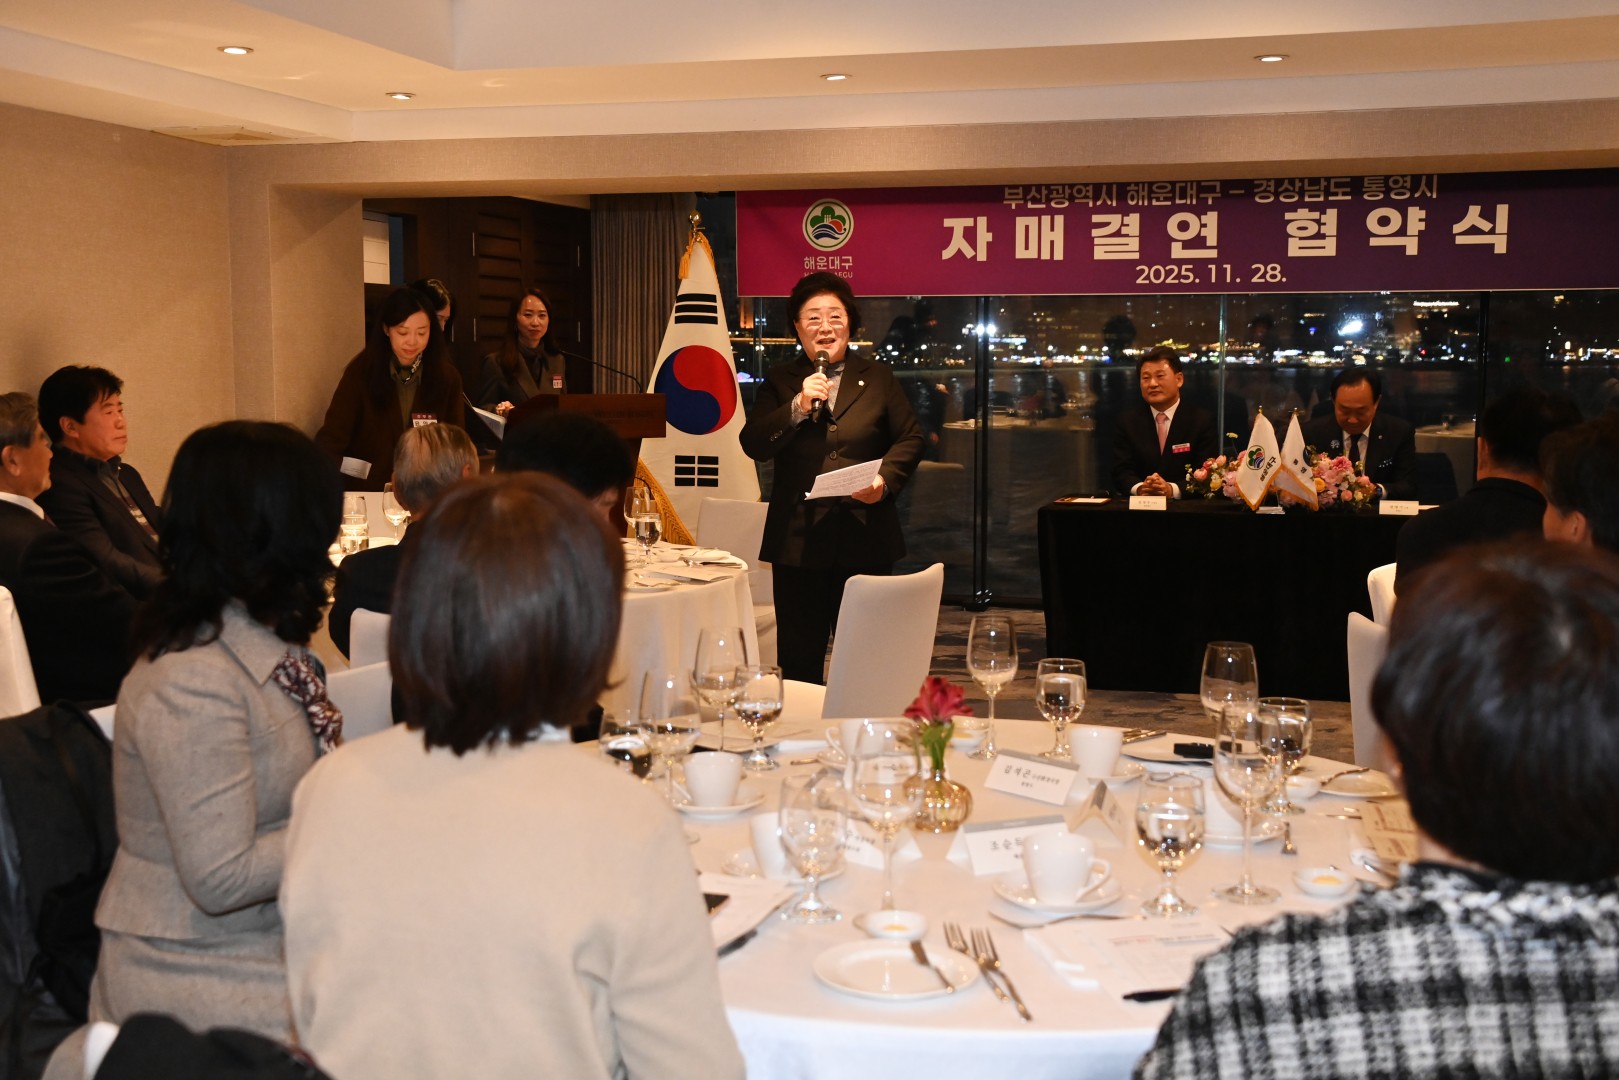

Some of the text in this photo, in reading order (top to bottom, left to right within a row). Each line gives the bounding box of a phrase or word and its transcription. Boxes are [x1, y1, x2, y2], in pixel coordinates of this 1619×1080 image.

[1003, 184, 1117, 209] 부산광역시
[1127, 181, 1221, 206] 해운대구
[1254, 176, 1352, 203] 경상남도
[1362, 173, 1438, 200] 통영시
[942, 204, 1509, 261] 자매결연 협약식
[804, 256, 853, 269] 해운대구
[1135, 263, 1287, 284] 2025. 11. 28.
